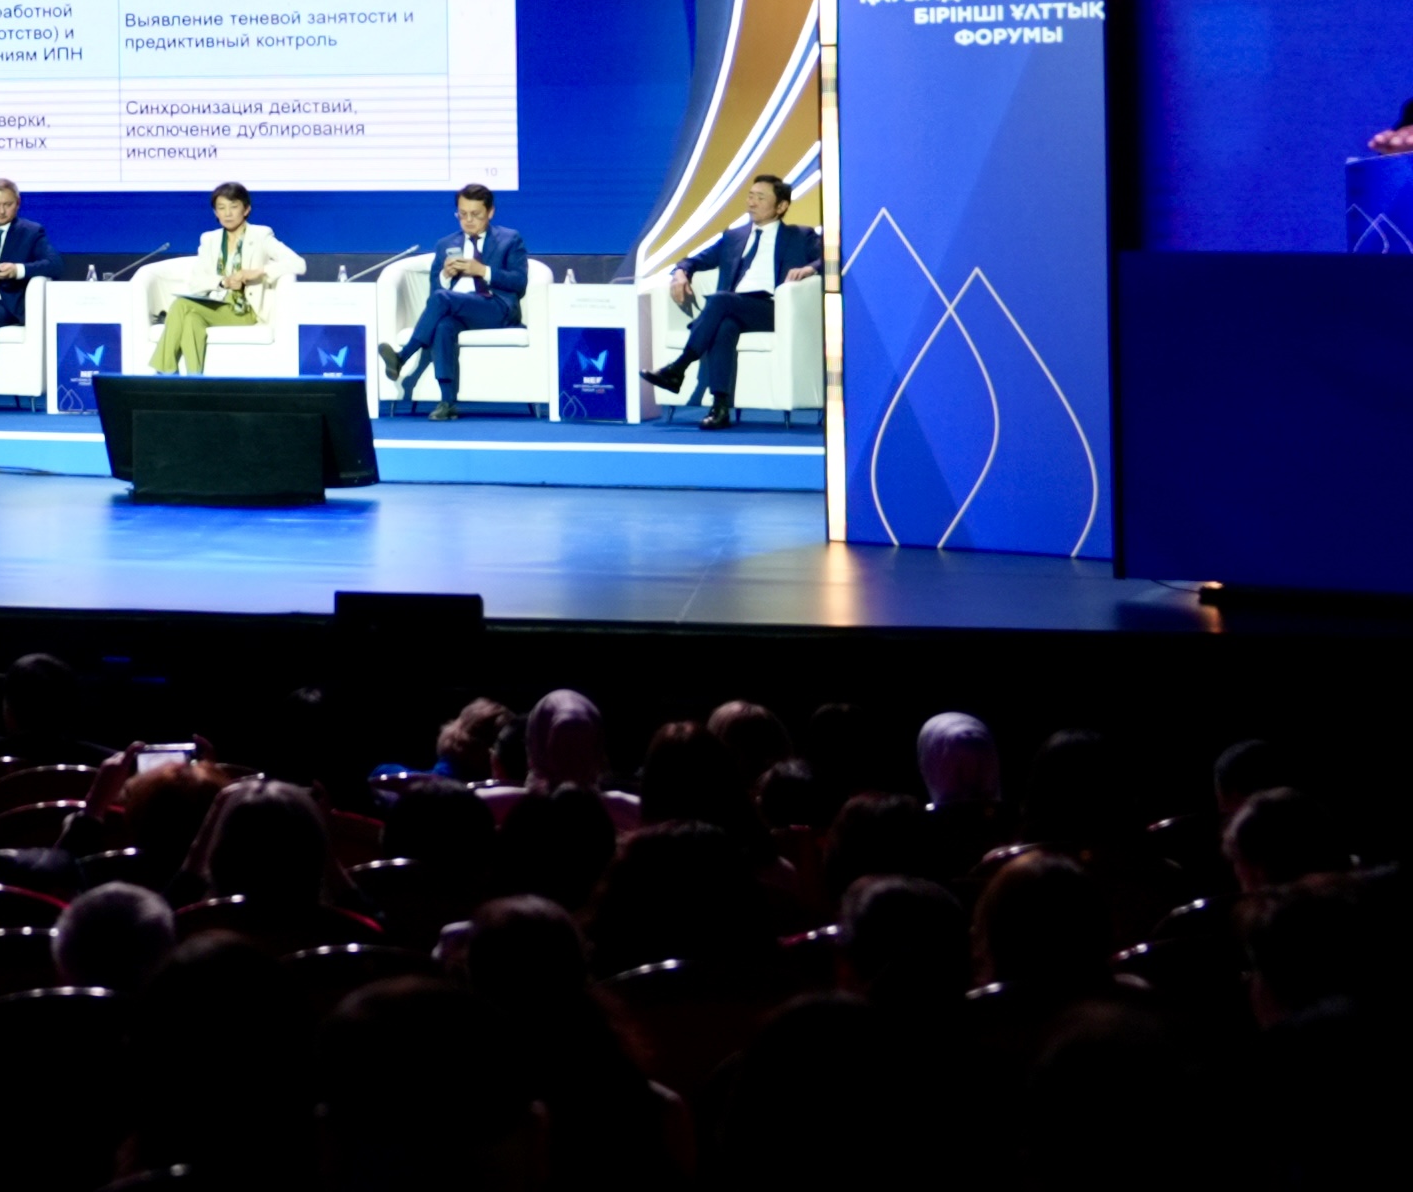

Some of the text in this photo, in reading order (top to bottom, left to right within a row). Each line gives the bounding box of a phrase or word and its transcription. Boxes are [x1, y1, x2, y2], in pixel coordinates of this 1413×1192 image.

[124, 10, 414, 28] Выявление теневой занятости и
[914, 0, 1105, 25] БІРІНШІ ҰЛТТЫҚ
[64, 27, 74, 40] и
[124, 33, 338, 51] предиктивный контроль
[953, 26, 1063, 46] ФОРУМЫ
[43, 47, 83, 61] ИПН
[125, 100, 264, 117] Синхронизация
[126, 121, 366, 138] исключение дублирования
[126, 143, 218, 161] инспекций
